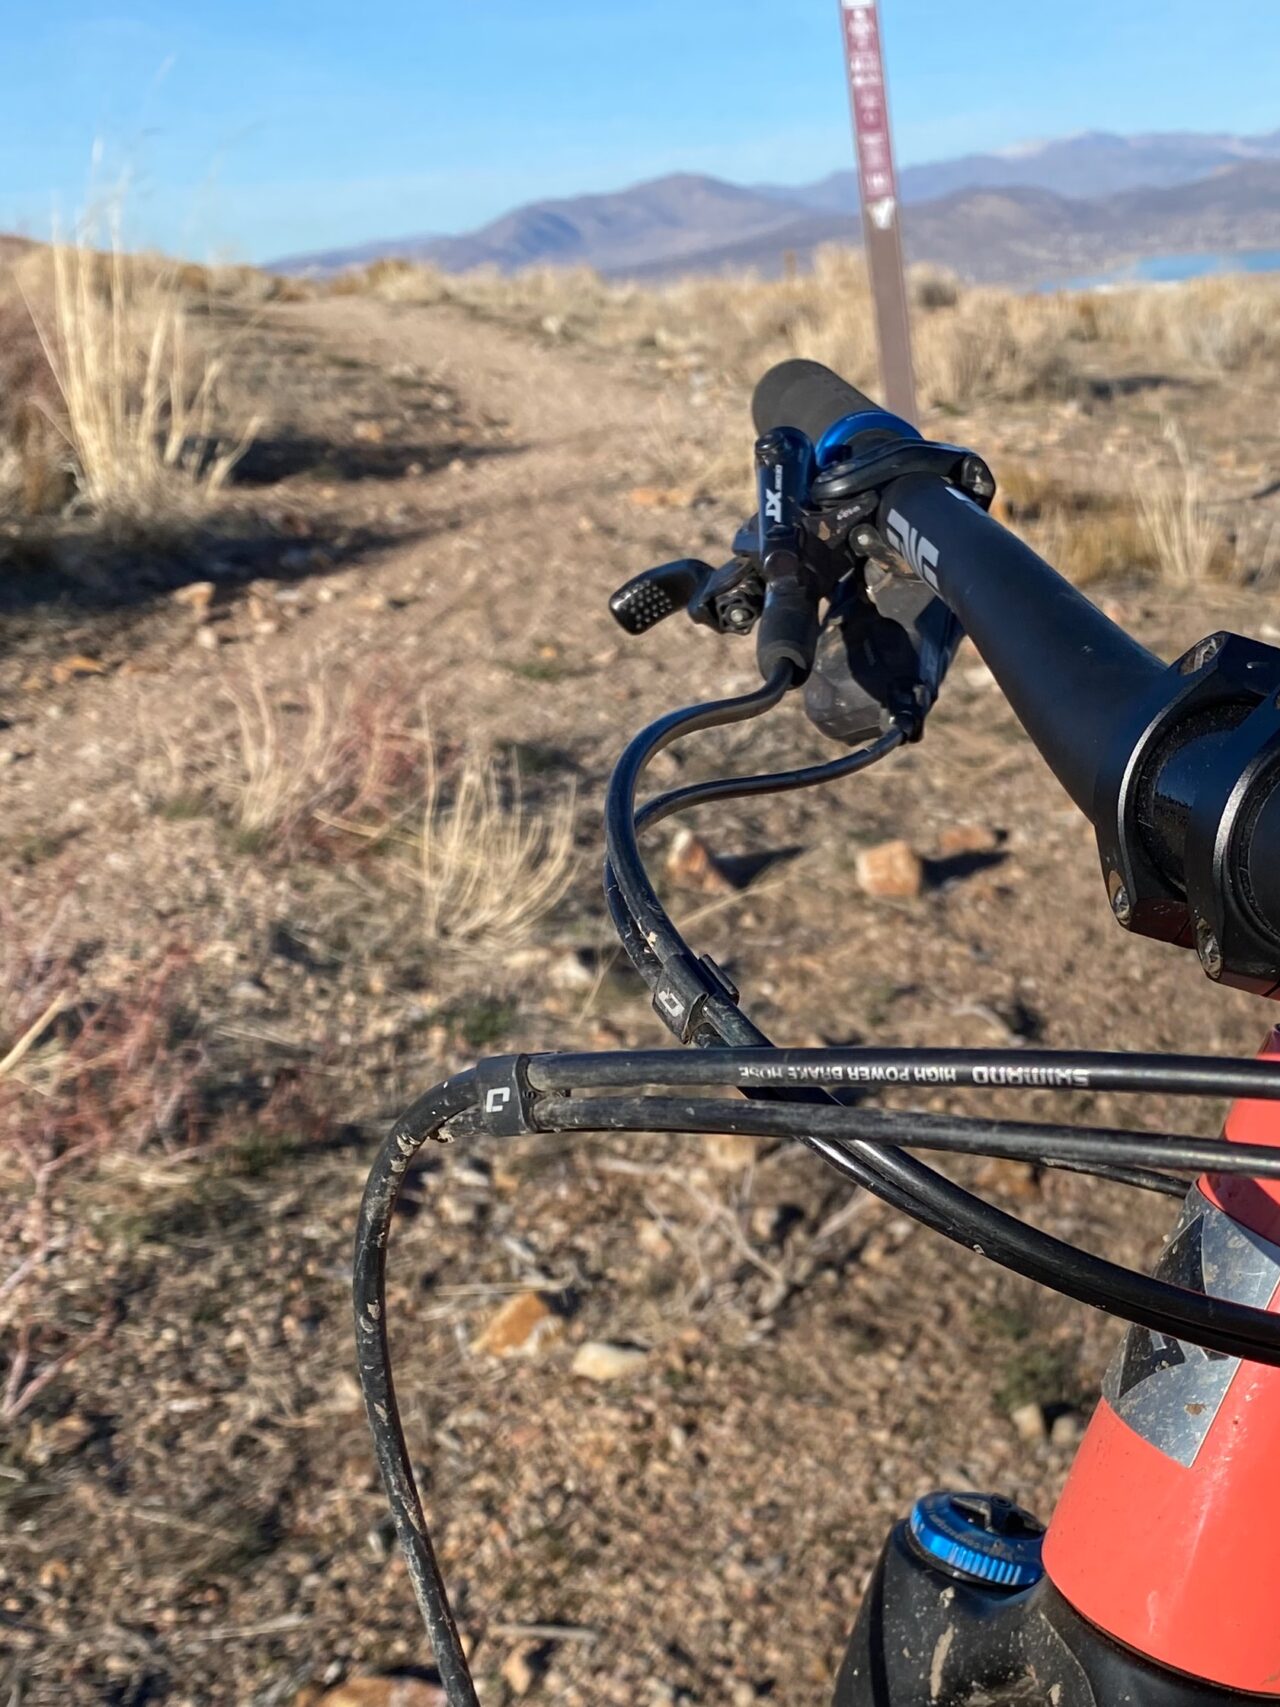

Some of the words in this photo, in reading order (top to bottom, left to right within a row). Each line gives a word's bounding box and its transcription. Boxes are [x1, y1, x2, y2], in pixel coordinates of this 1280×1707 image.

[765, 488, 782, 523] XT
[788, 1066, 843, 1081] BRAKE
[847, 1066, 910, 1082] POWER
[914, 1067, 957, 1082] HIGH
[972, 1066, 1089, 1086] SHIMANO
